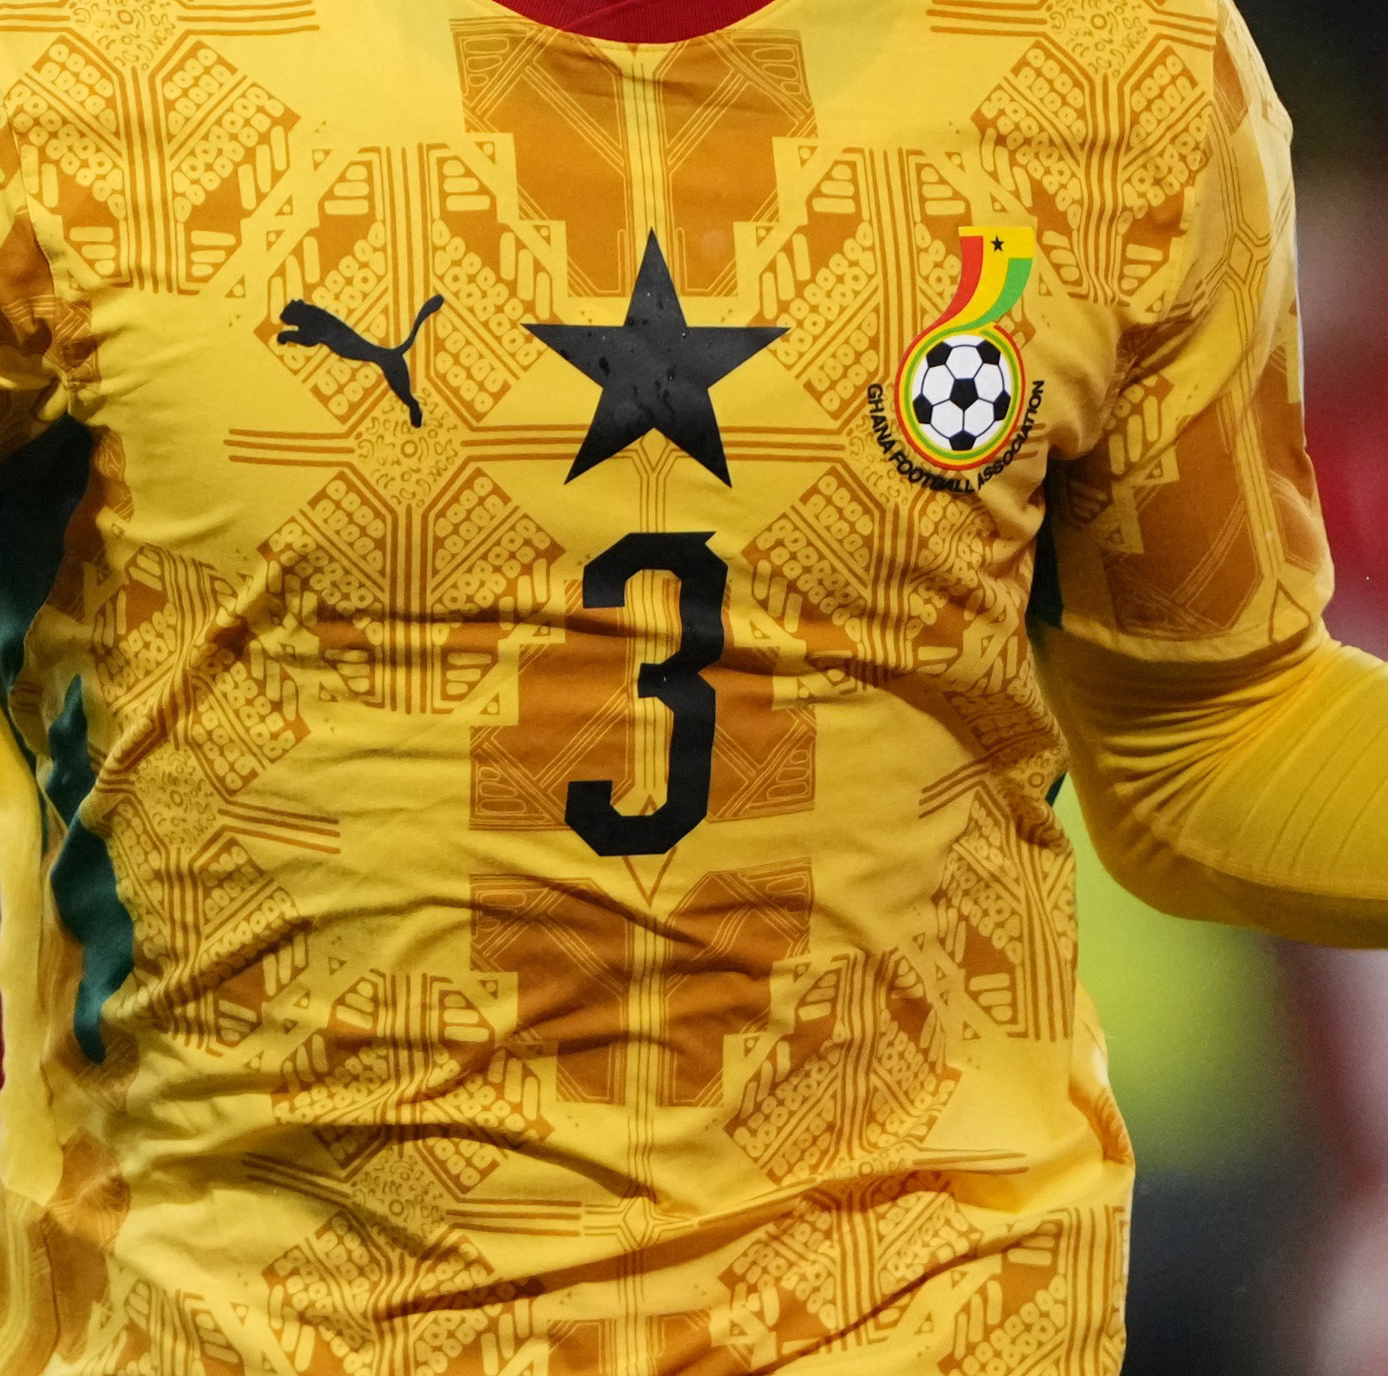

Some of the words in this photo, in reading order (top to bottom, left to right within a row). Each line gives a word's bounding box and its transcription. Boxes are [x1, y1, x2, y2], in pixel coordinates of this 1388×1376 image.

[867, 383, 896, 454] GHANA
[888, 450, 975, 493] FOOTBALL
[977, 380, 1045, 491] ASSOCIATION
[564, 531, 729, 857] 3
